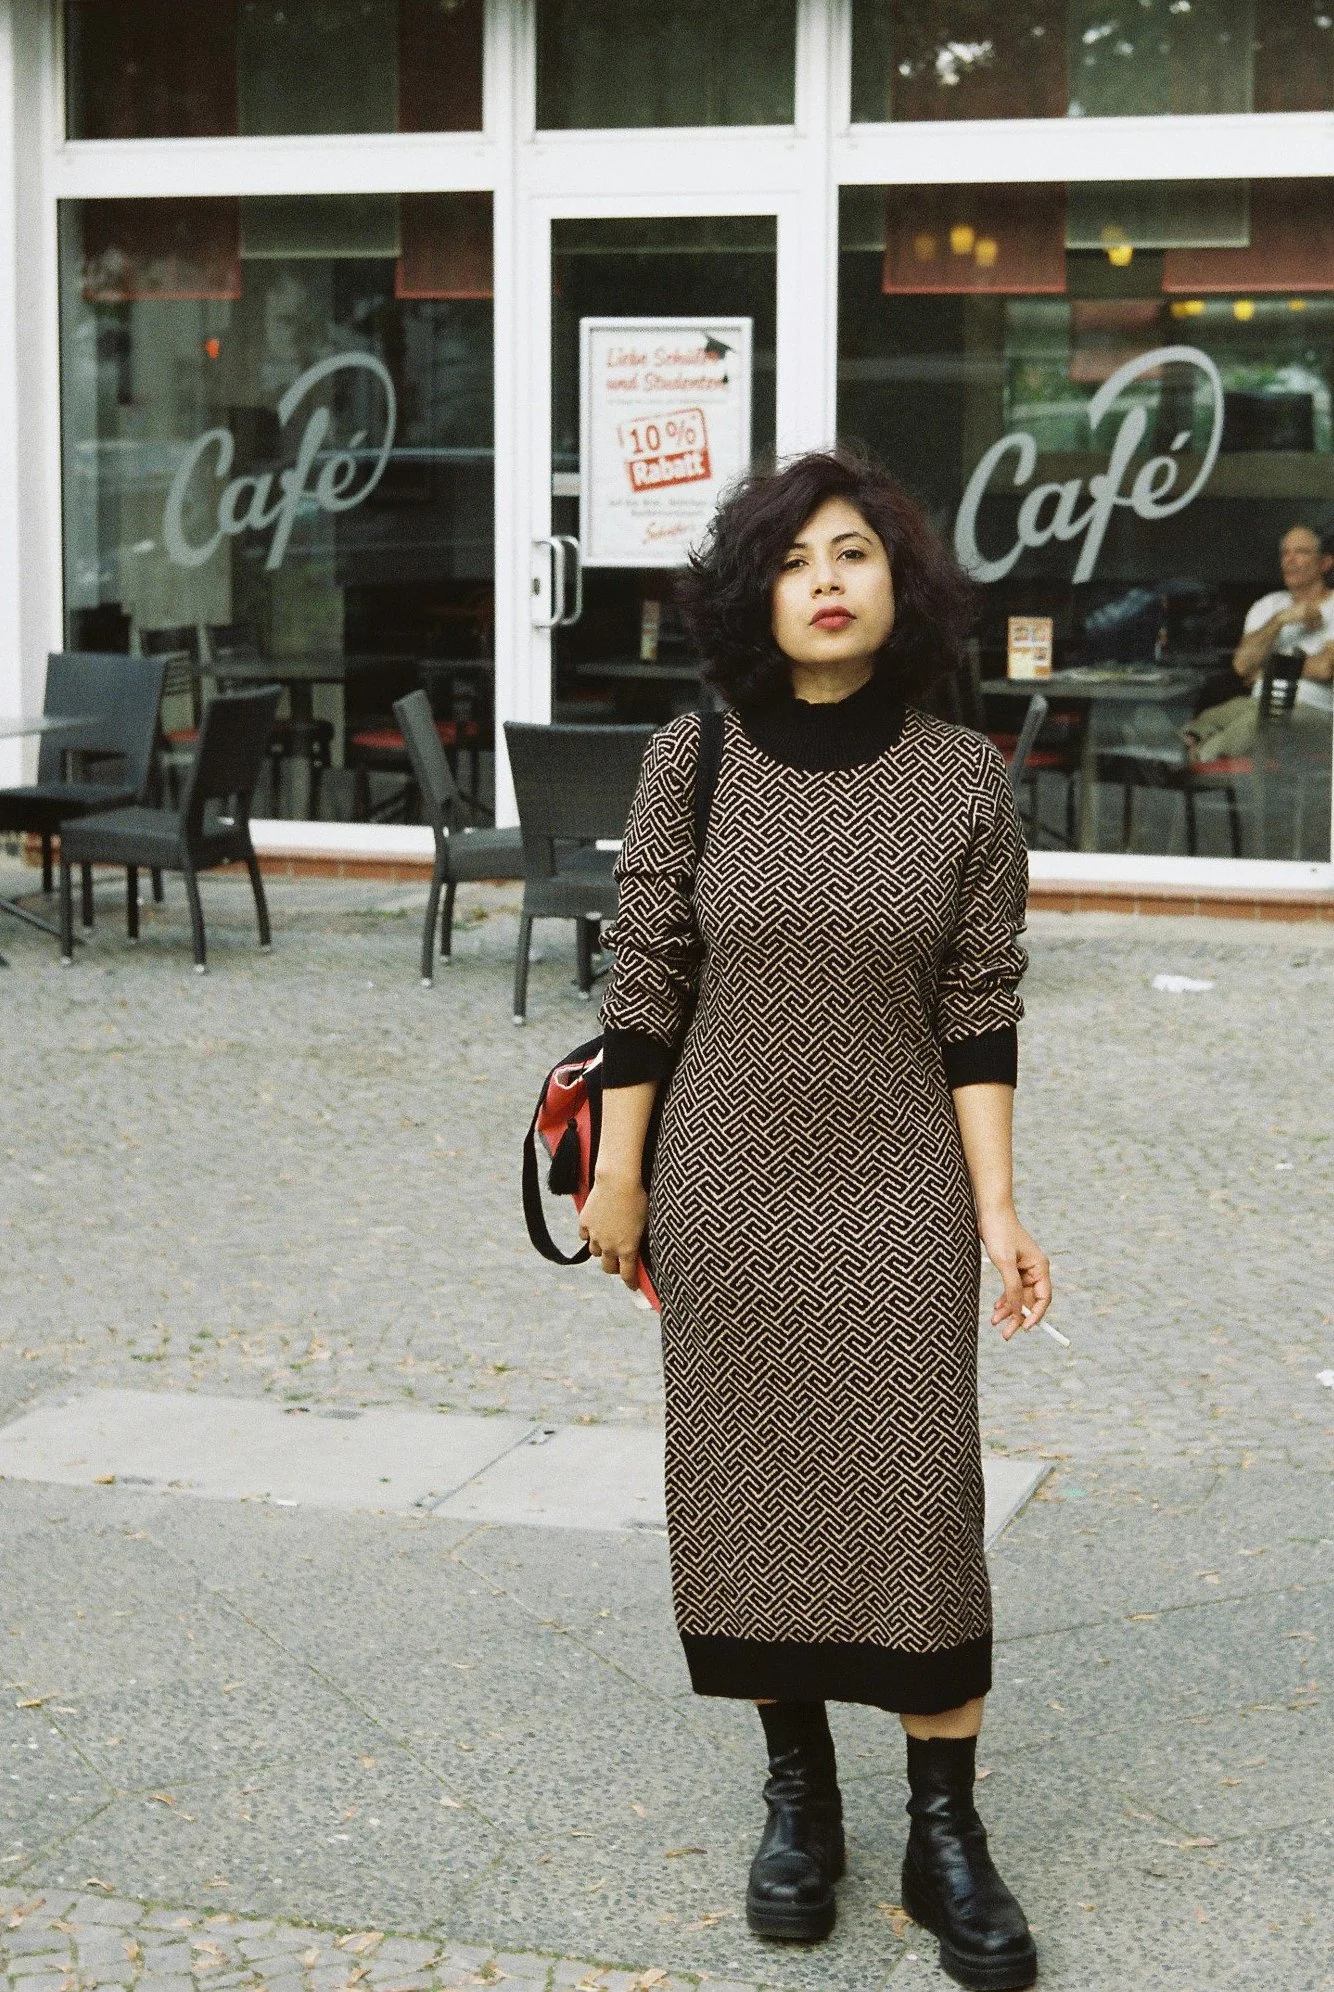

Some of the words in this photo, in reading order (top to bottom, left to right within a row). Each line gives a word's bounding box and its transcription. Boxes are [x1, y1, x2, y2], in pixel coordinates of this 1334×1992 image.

[163, 351, 397, 571] Café
[631, 451, 706, 487] Rabatt
[953, 344, 1225, 584] Café
